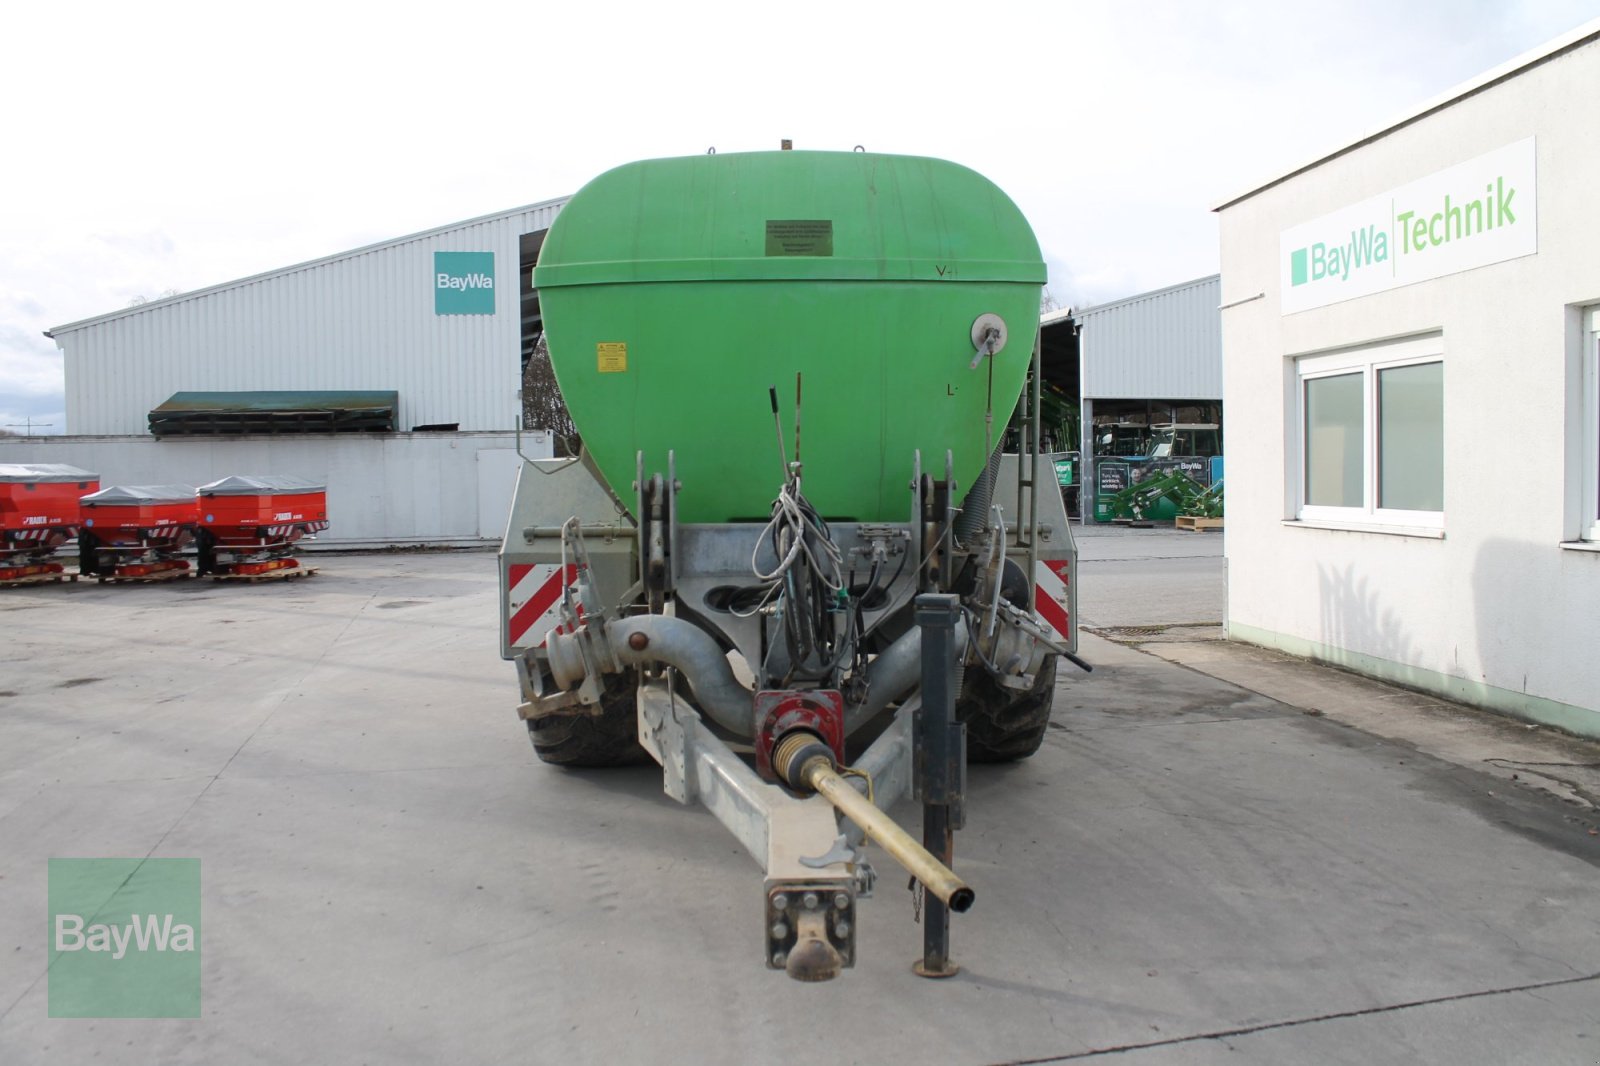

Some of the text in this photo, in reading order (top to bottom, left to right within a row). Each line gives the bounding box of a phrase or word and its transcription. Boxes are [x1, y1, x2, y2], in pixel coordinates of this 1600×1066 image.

[1312, 176, 1516, 282] BayWa Technik
[437, 273, 493, 292] BayWa
[1180, 462, 1202, 471] BayWa
